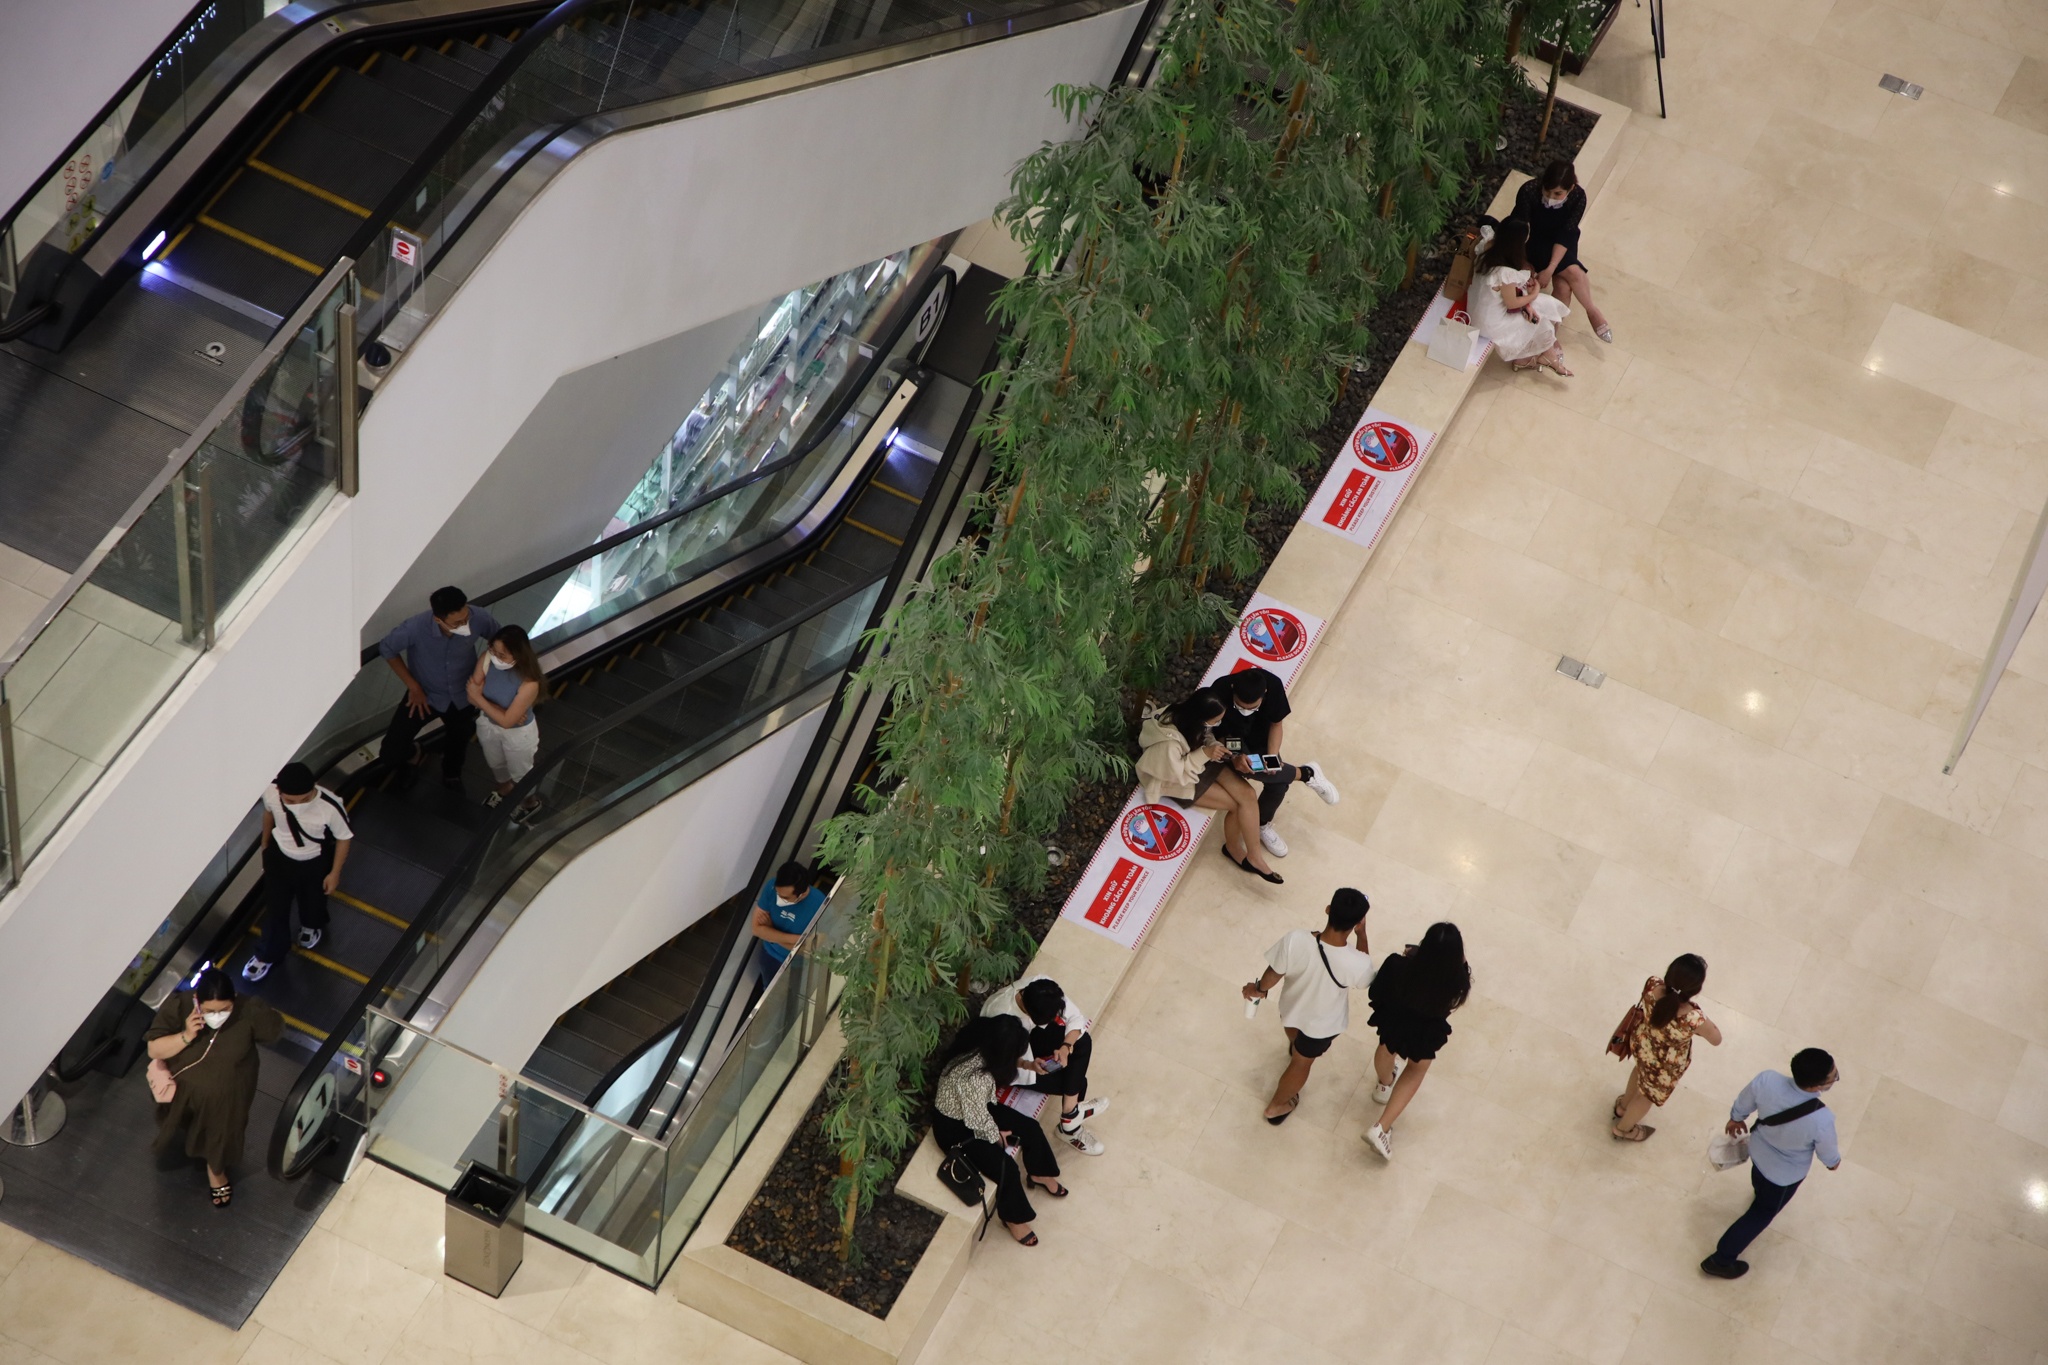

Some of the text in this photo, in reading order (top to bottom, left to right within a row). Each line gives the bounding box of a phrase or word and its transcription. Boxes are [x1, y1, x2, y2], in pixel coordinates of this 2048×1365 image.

[919, 292, 940, 337] B1
[1339, 497, 1347, 507] XIN
[1349, 495, 1359, 508] CÁCH
[1356, 487, 1363, 495] AN
[1349, 517, 1359, 531] PLEASE
[1369, 480, 1381, 498] DISTANCE
[1103, 891, 1112, 901] XIN
[1112, 913, 1124, 929] PLEASE
[1128, 891, 1137, 902] YOUR
[1135, 871, 1150, 891] DISTANCE
[1113, 887, 1125, 902] CÁCH
[1122, 879, 1129, 888] AN
[1378, 1132, 1391, 1154] BOSTON
